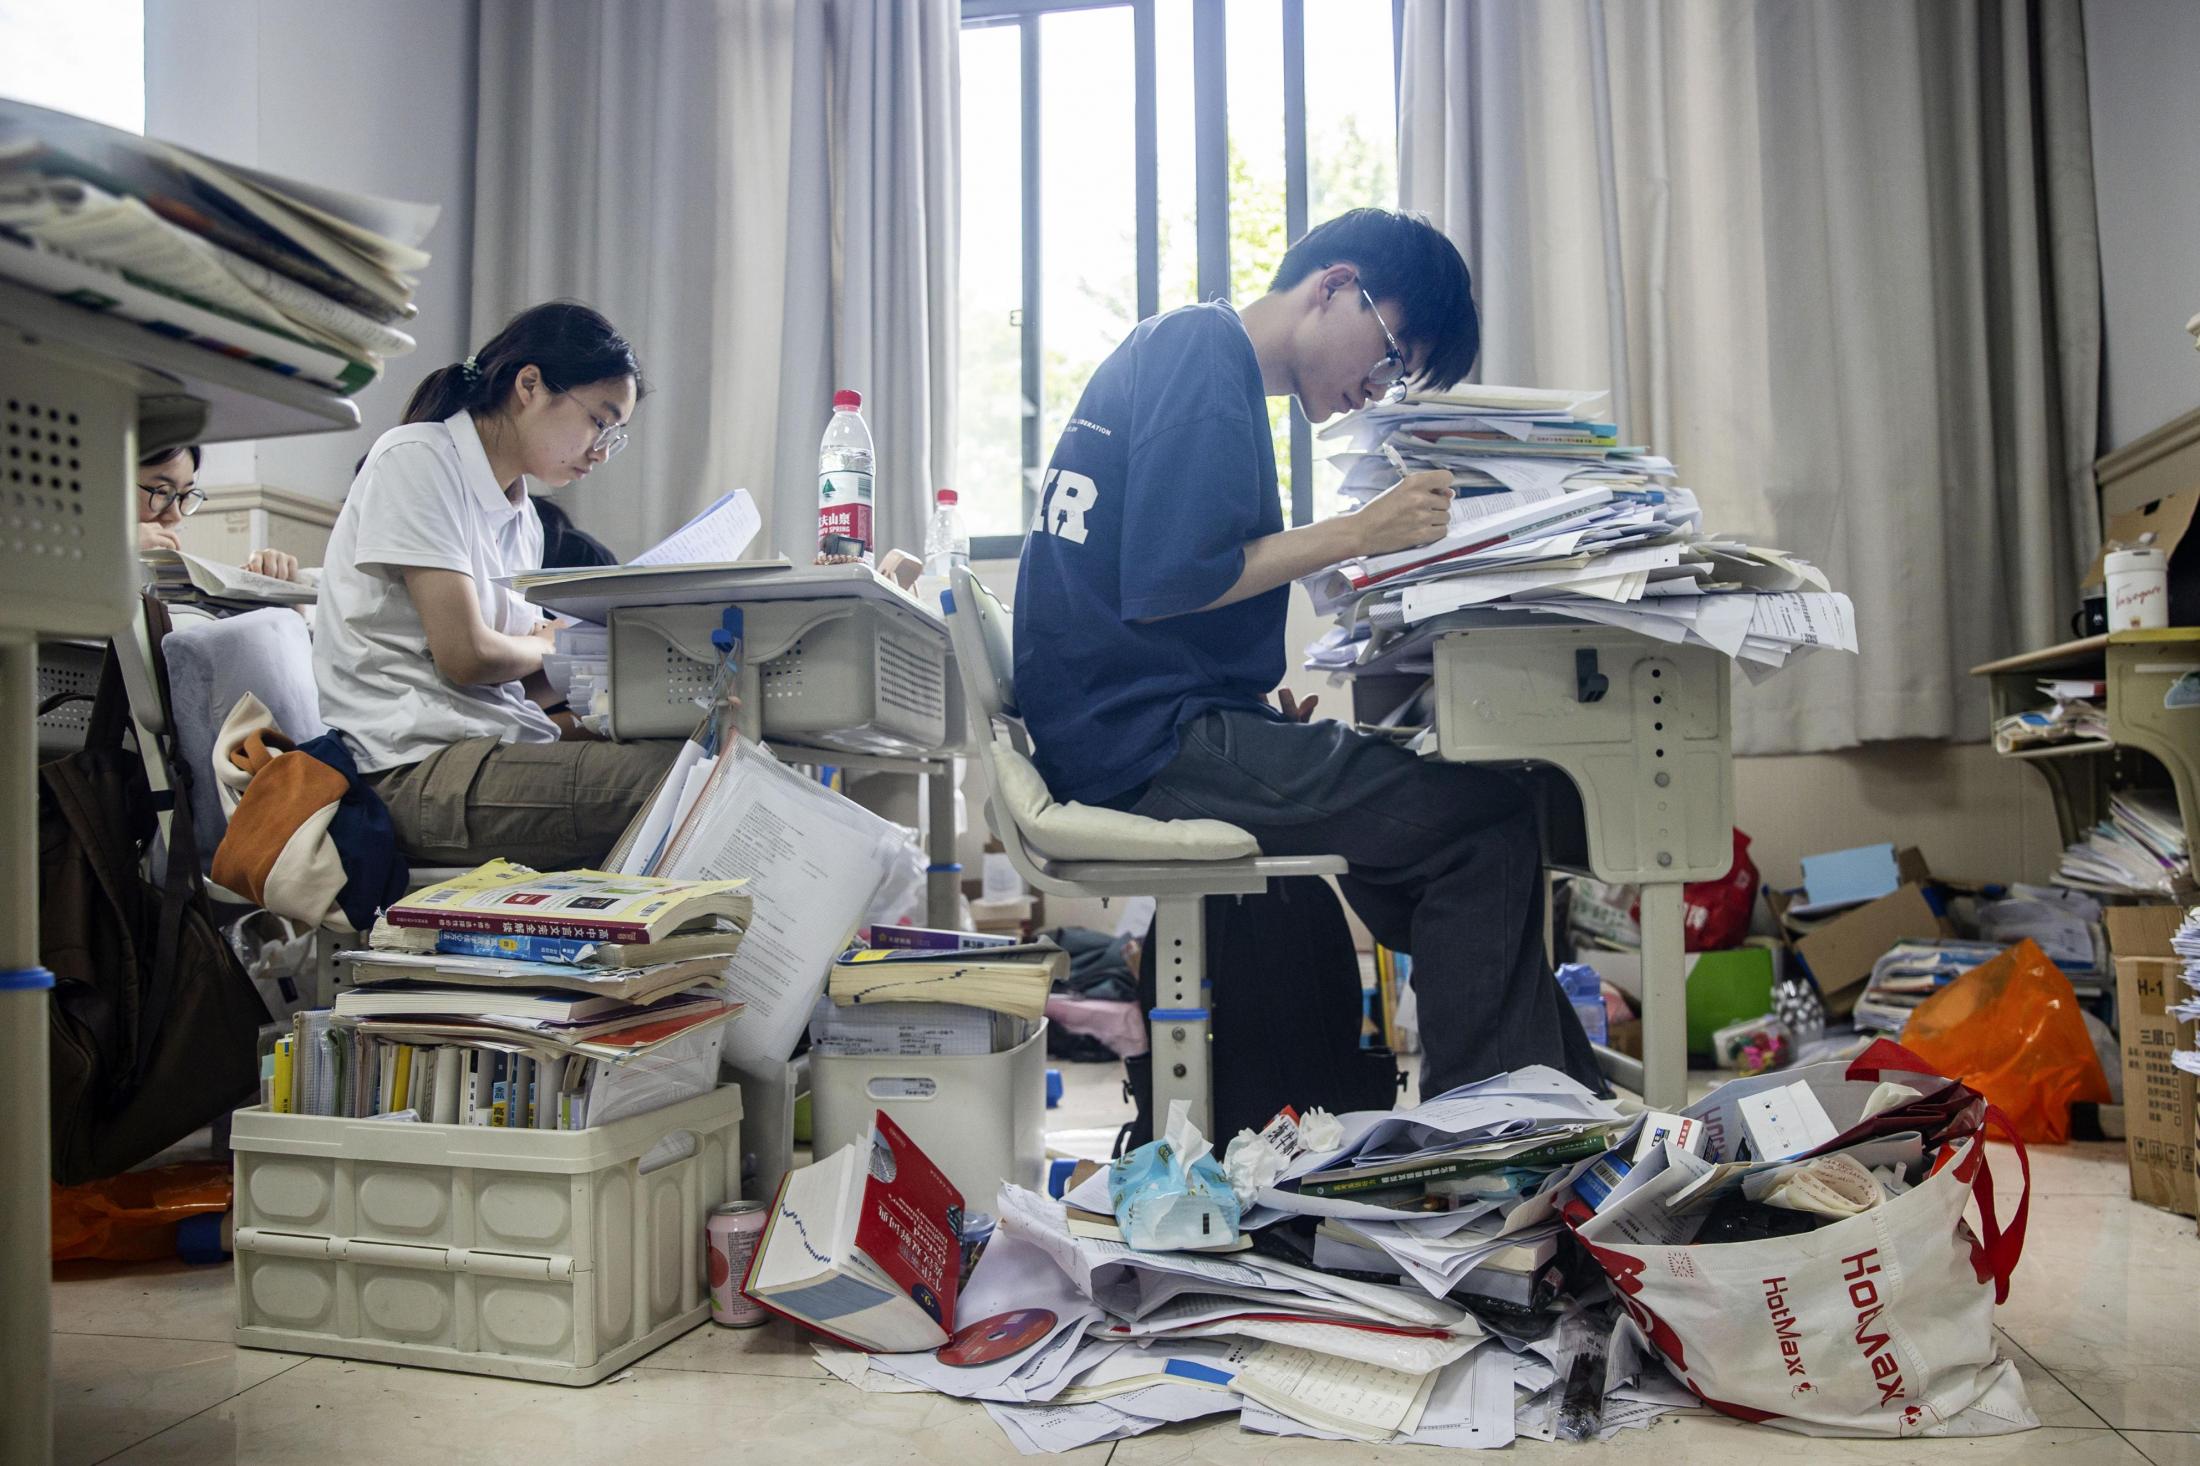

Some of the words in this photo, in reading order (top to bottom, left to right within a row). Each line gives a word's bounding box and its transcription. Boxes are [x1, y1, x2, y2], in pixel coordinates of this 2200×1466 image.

[818, 512, 851, 527] 夫山泉
[2137, 978, 2165, 998] H-1
[912, 1224, 946, 1266] Oxford
